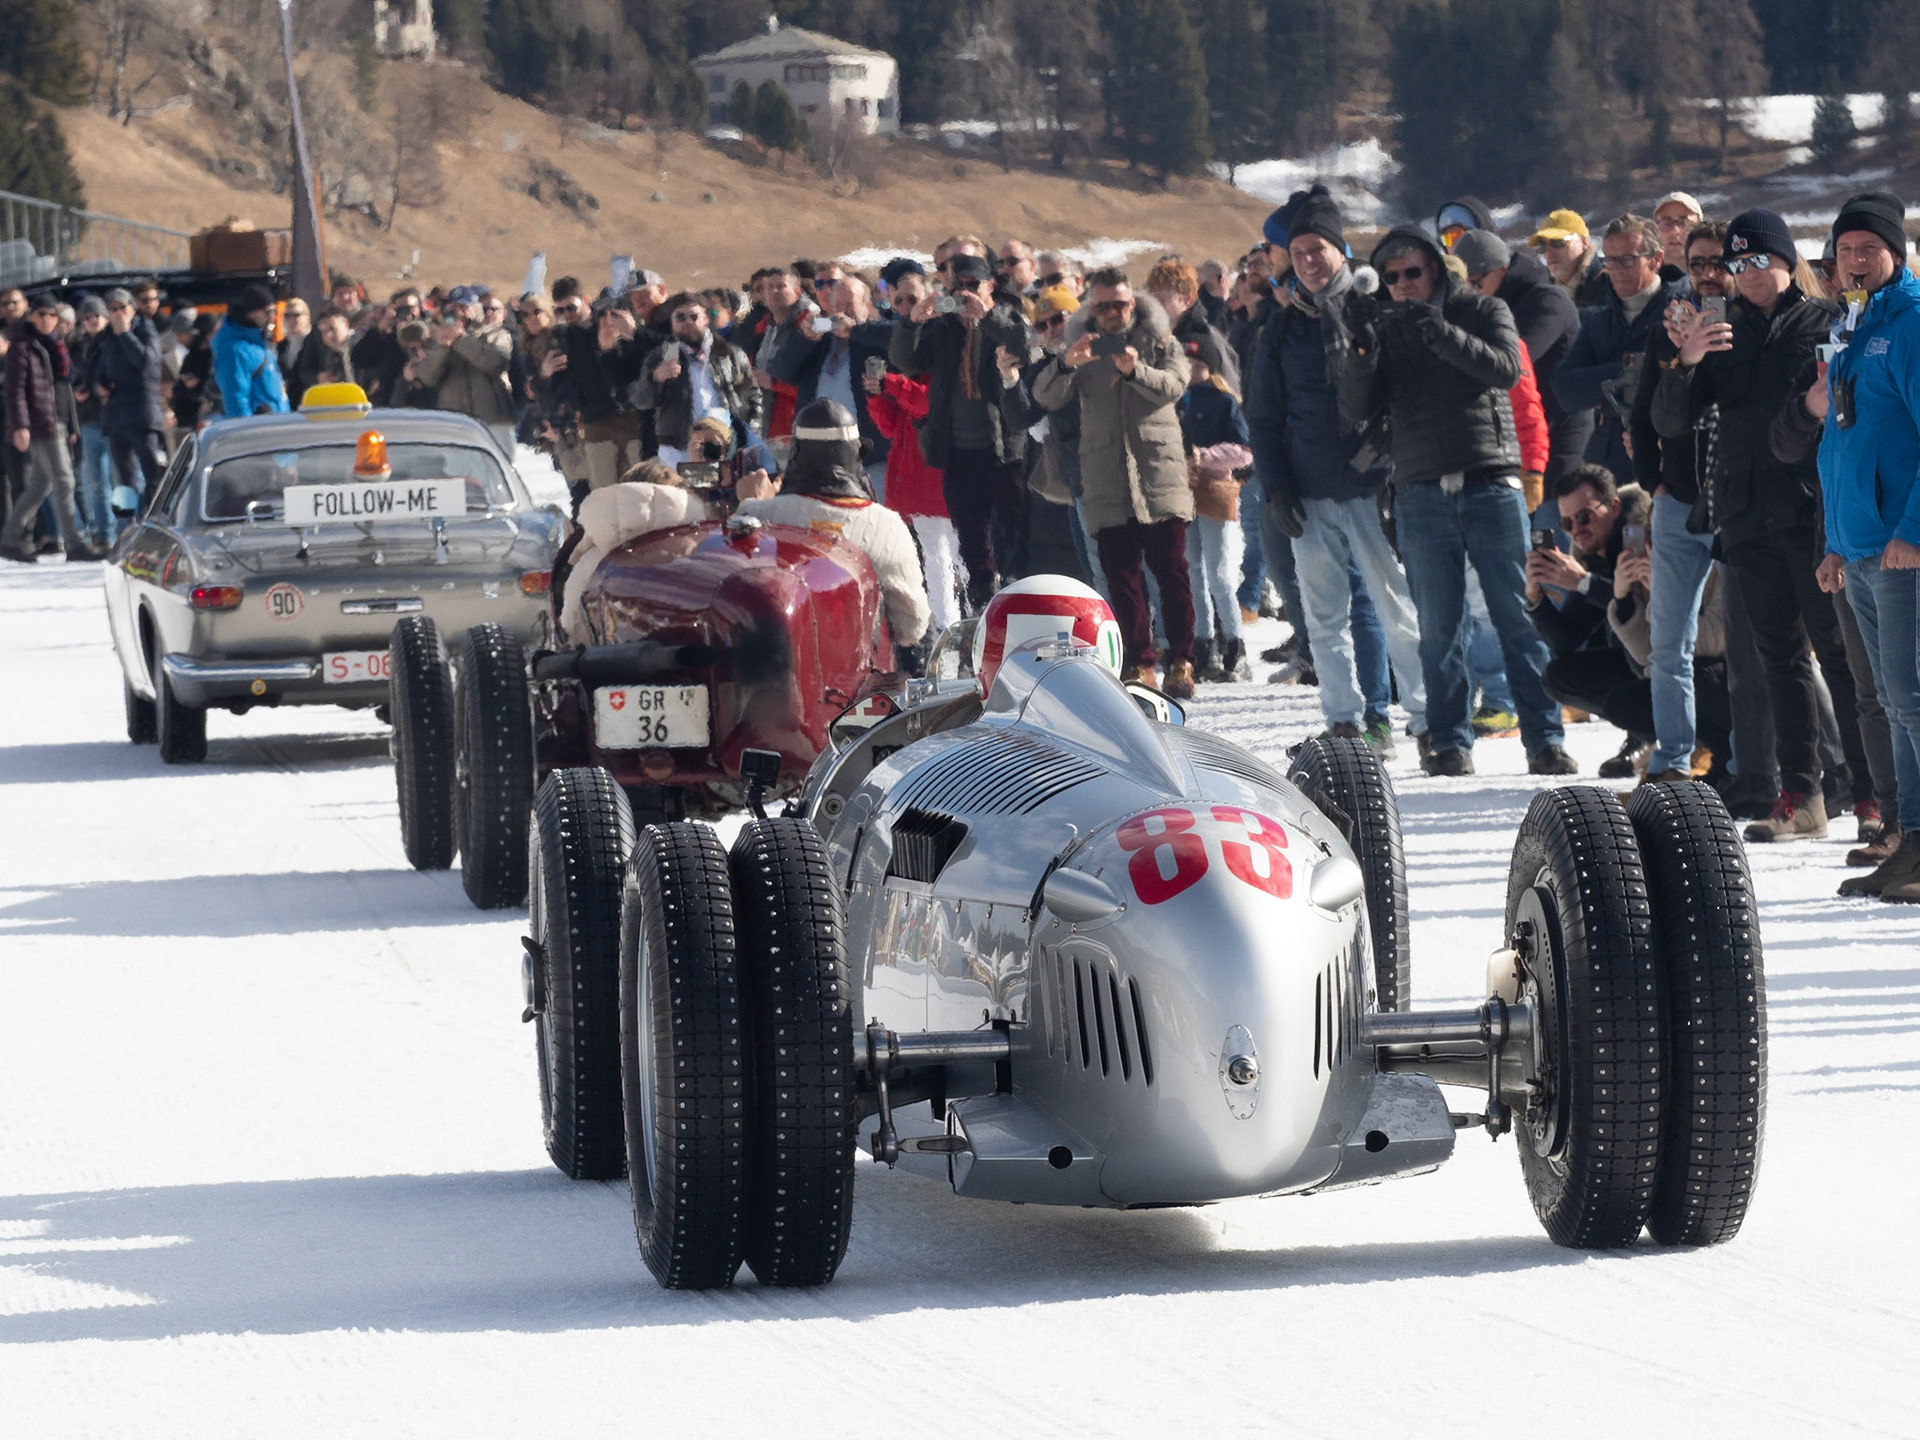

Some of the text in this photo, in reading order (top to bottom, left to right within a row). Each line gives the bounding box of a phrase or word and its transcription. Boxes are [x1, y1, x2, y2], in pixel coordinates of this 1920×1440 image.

[313, 487, 439, 517] FOLLOW-ME
[273, 592, 295, 616] 90
[639, 690, 665, 711] GR
[638, 714, 668, 742] 36
[1115, 805, 1293, 906] 83
